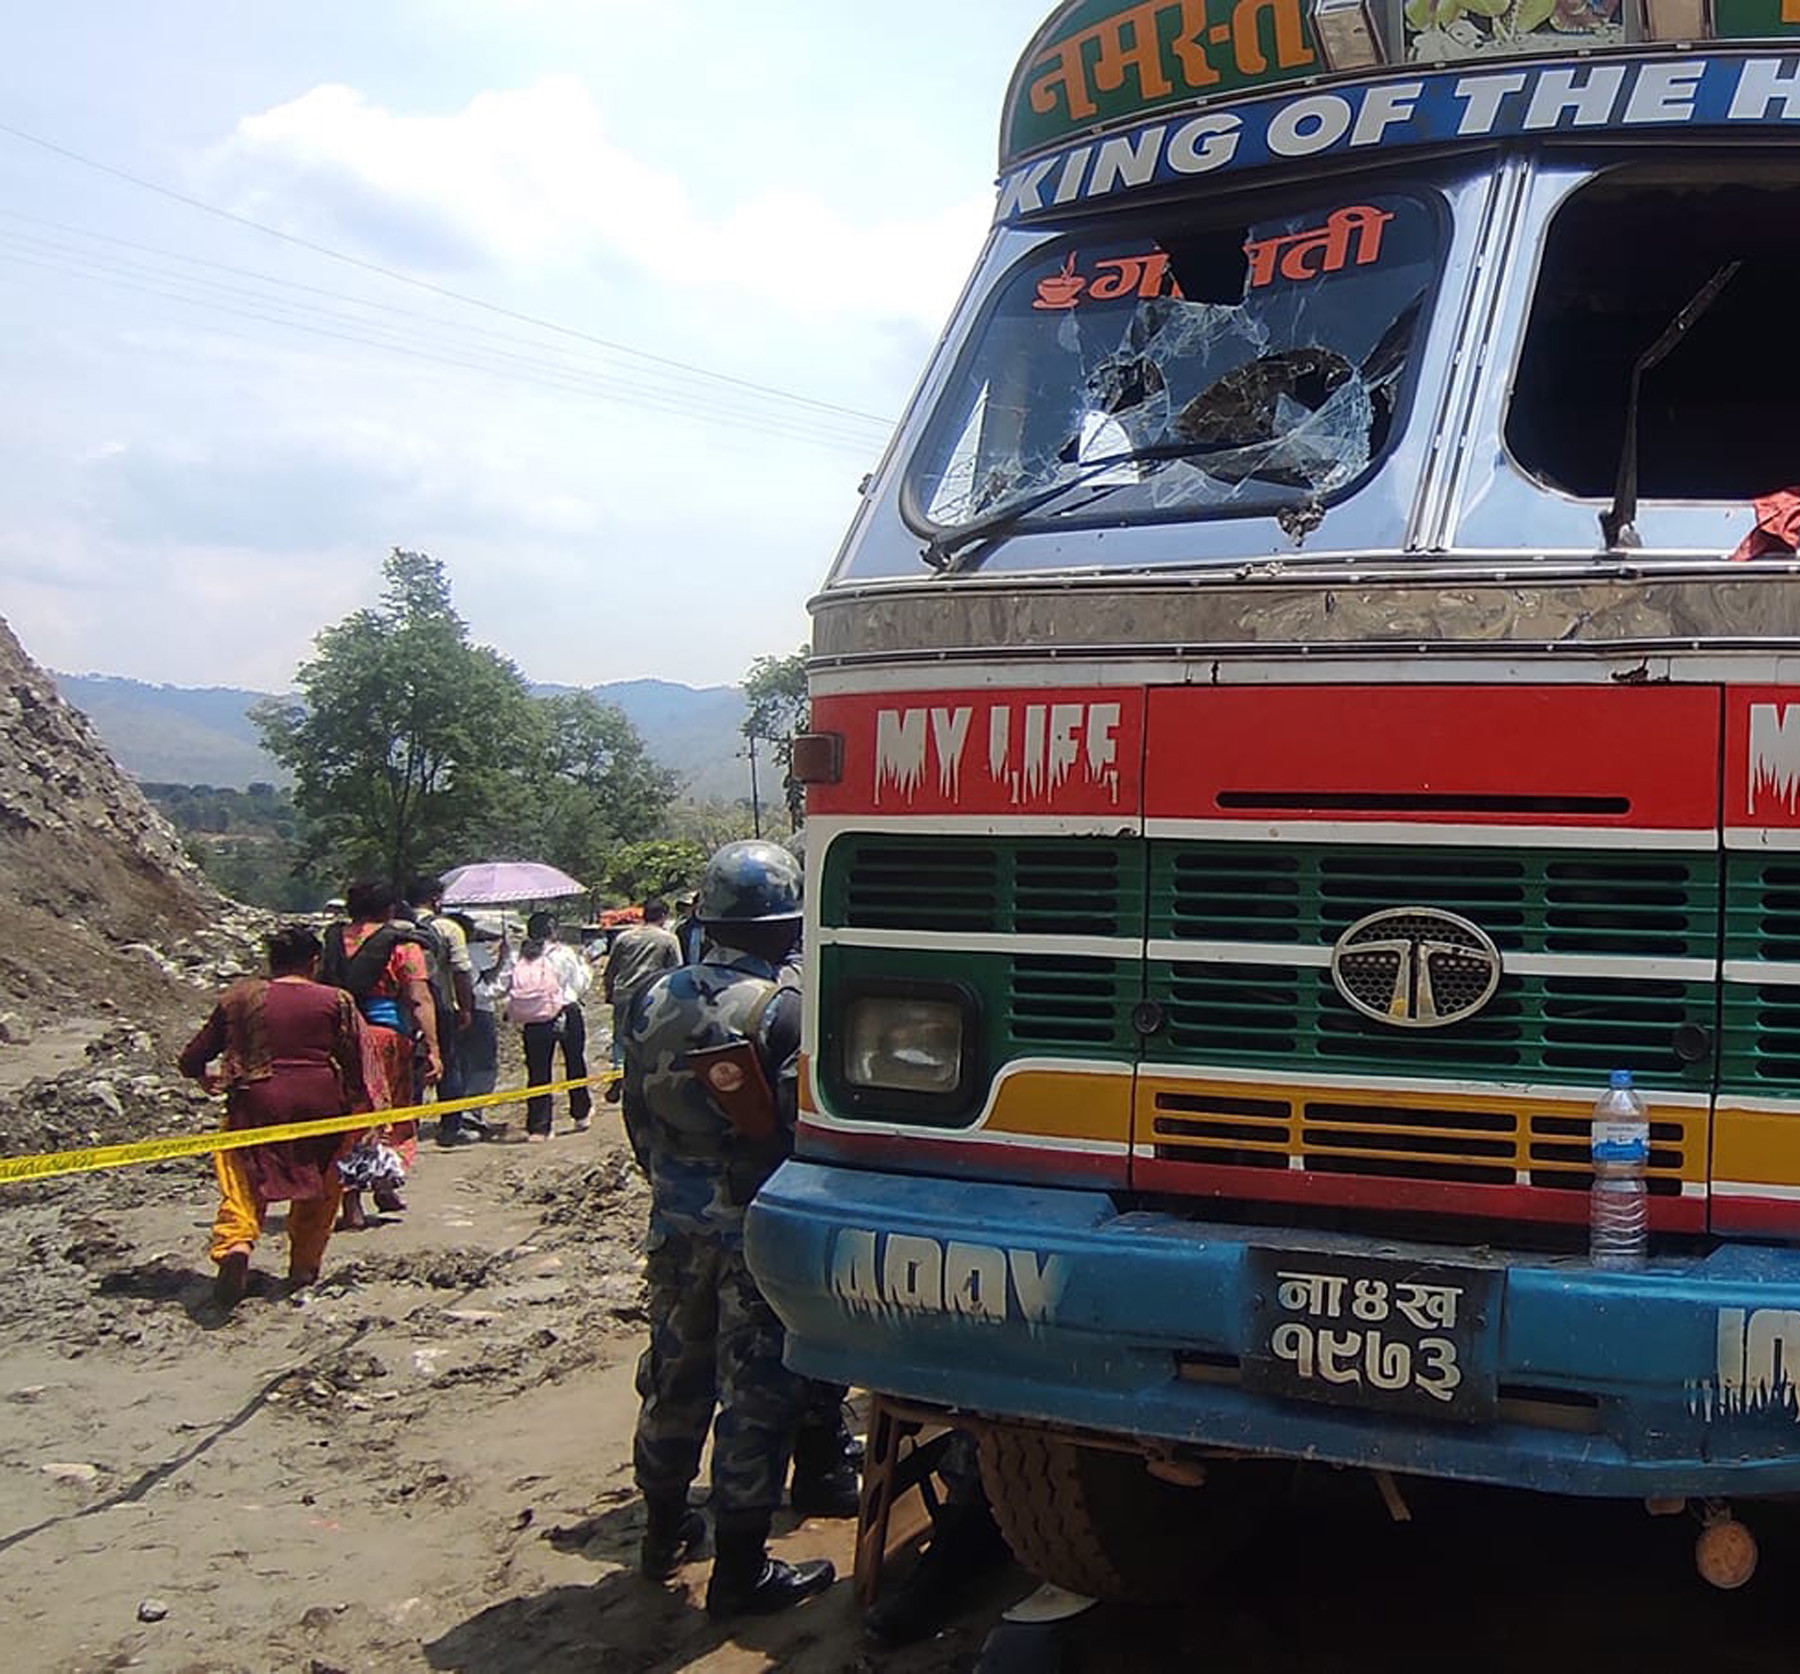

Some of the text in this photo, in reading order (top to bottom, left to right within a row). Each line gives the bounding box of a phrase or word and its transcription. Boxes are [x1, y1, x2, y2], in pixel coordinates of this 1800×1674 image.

[1000, 112, 1244, 218] KING
[1265, 83, 1424, 159] OF
[1454, 59, 1708, 136] THE
[873, 702, 1121, 805] MY LIFE
